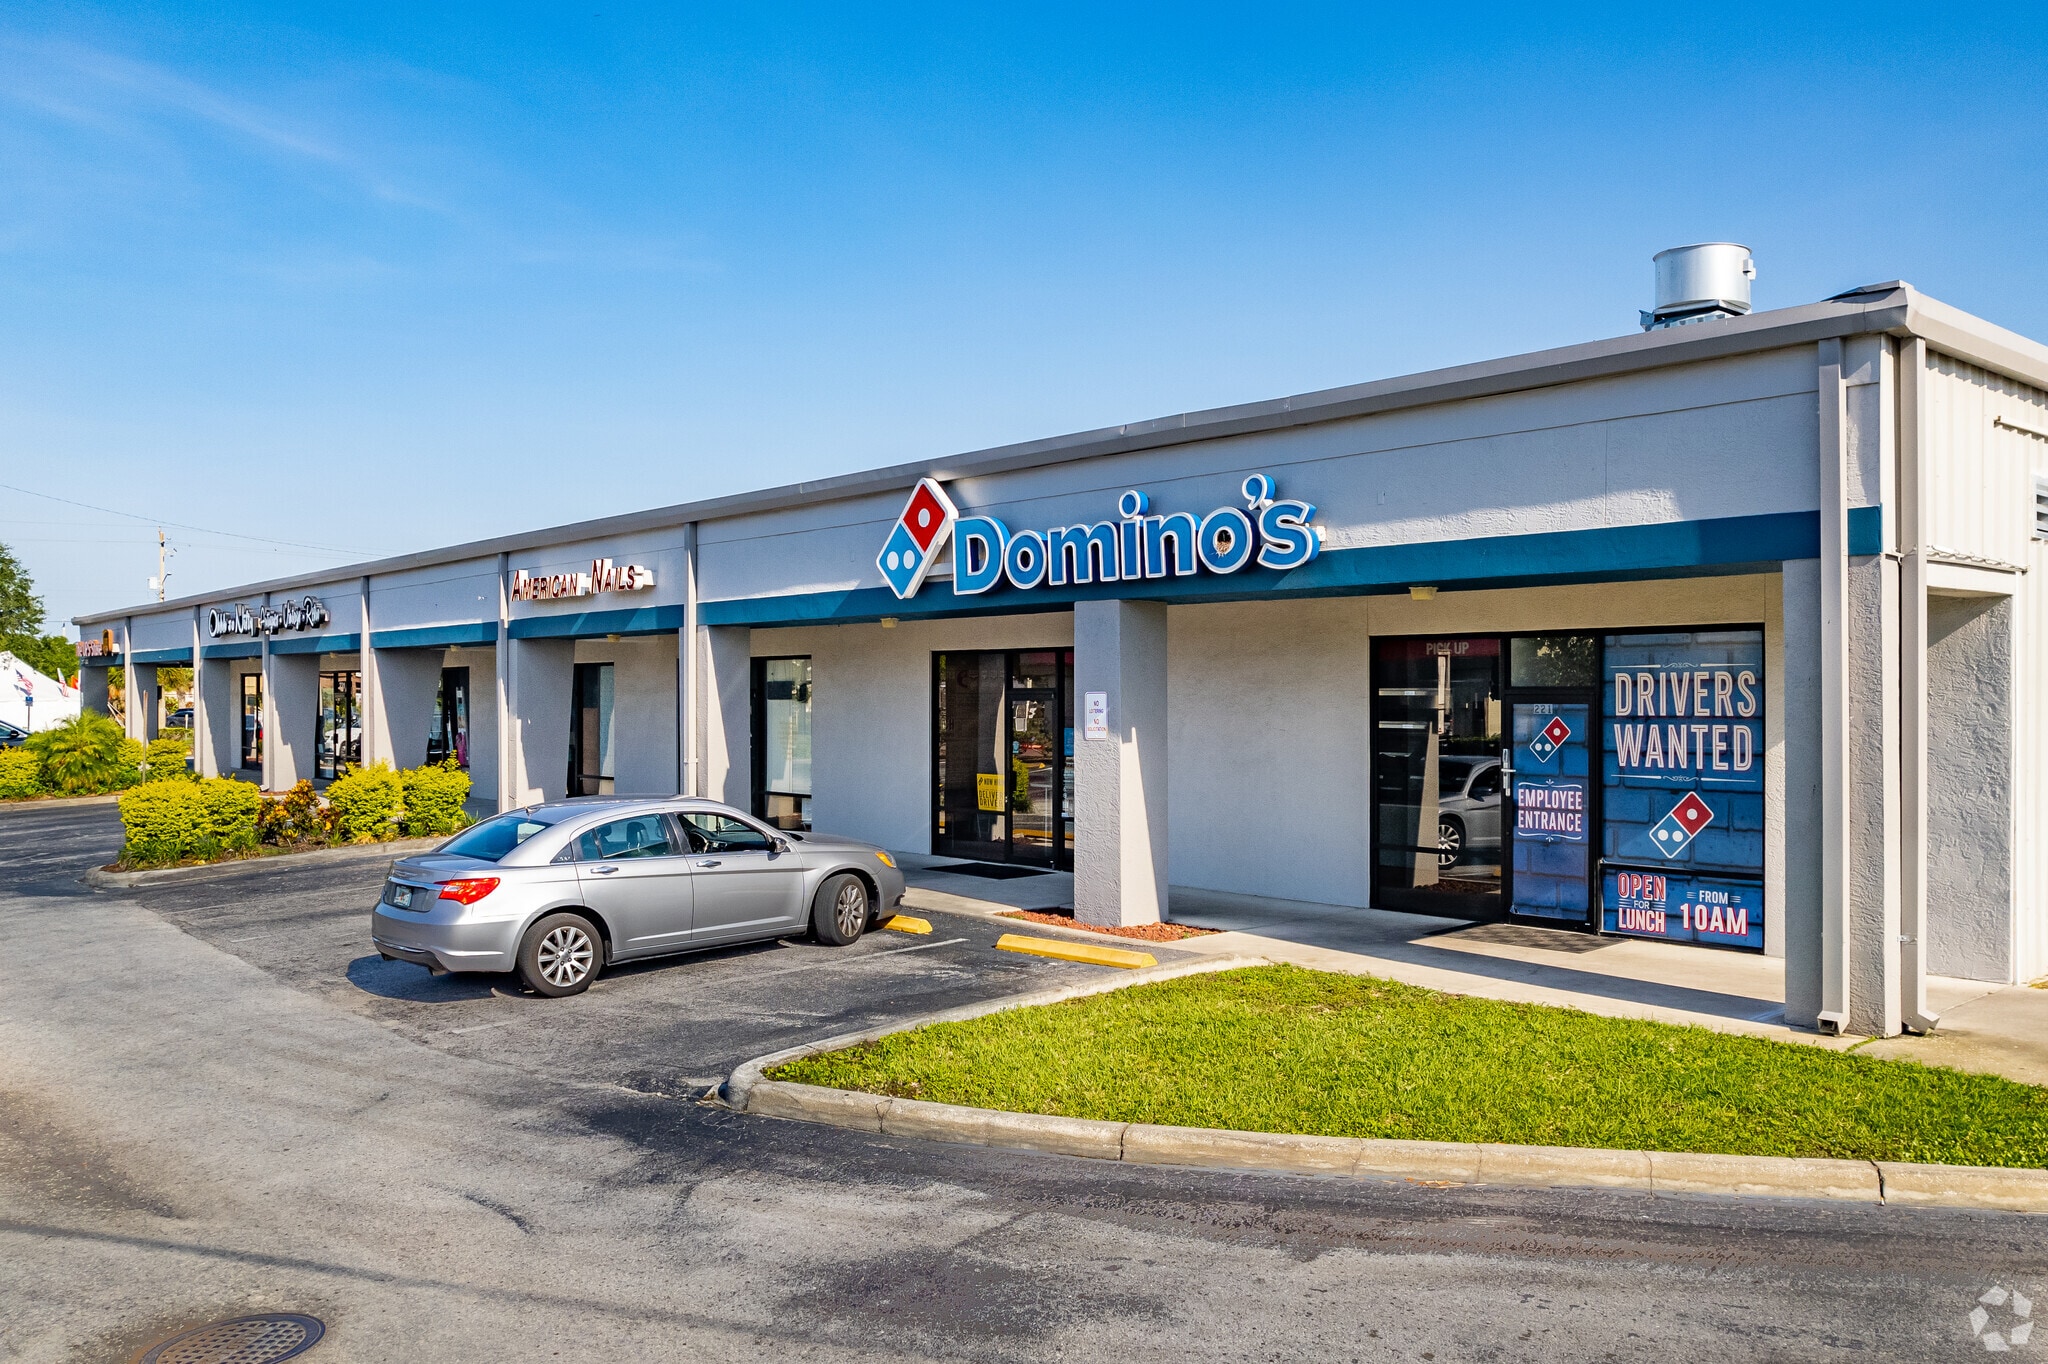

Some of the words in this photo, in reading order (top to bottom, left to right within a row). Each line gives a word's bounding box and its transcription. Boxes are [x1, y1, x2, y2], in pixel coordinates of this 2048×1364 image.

[953, 474, 1320, 595] Domino's
[512, 570, 578, 601] AMERICAN
[592, 558, 635, 594] NAILS
[1426, 642, 1451, 655] PICK
[1454, 642, 1470, 654] UP
[1615, 671, 1756, 717] DRIVERS
[1534, 704, 1553, 714] 221
[1614, 724, 1752, 771] WANTED
[1518, 789, 1582, 810] EMPLOYEE
[1518, 810, 1582, 832] ENTRANCE
[1618, 873, 1666, 902] OPEN
[1700, 890, 1729, 905] FROM
[1634, 900, 1650, 909] FOR
[1618, 907, 1666, 934] LUNCH
[1680, 903, 1748, 937] 10AM
